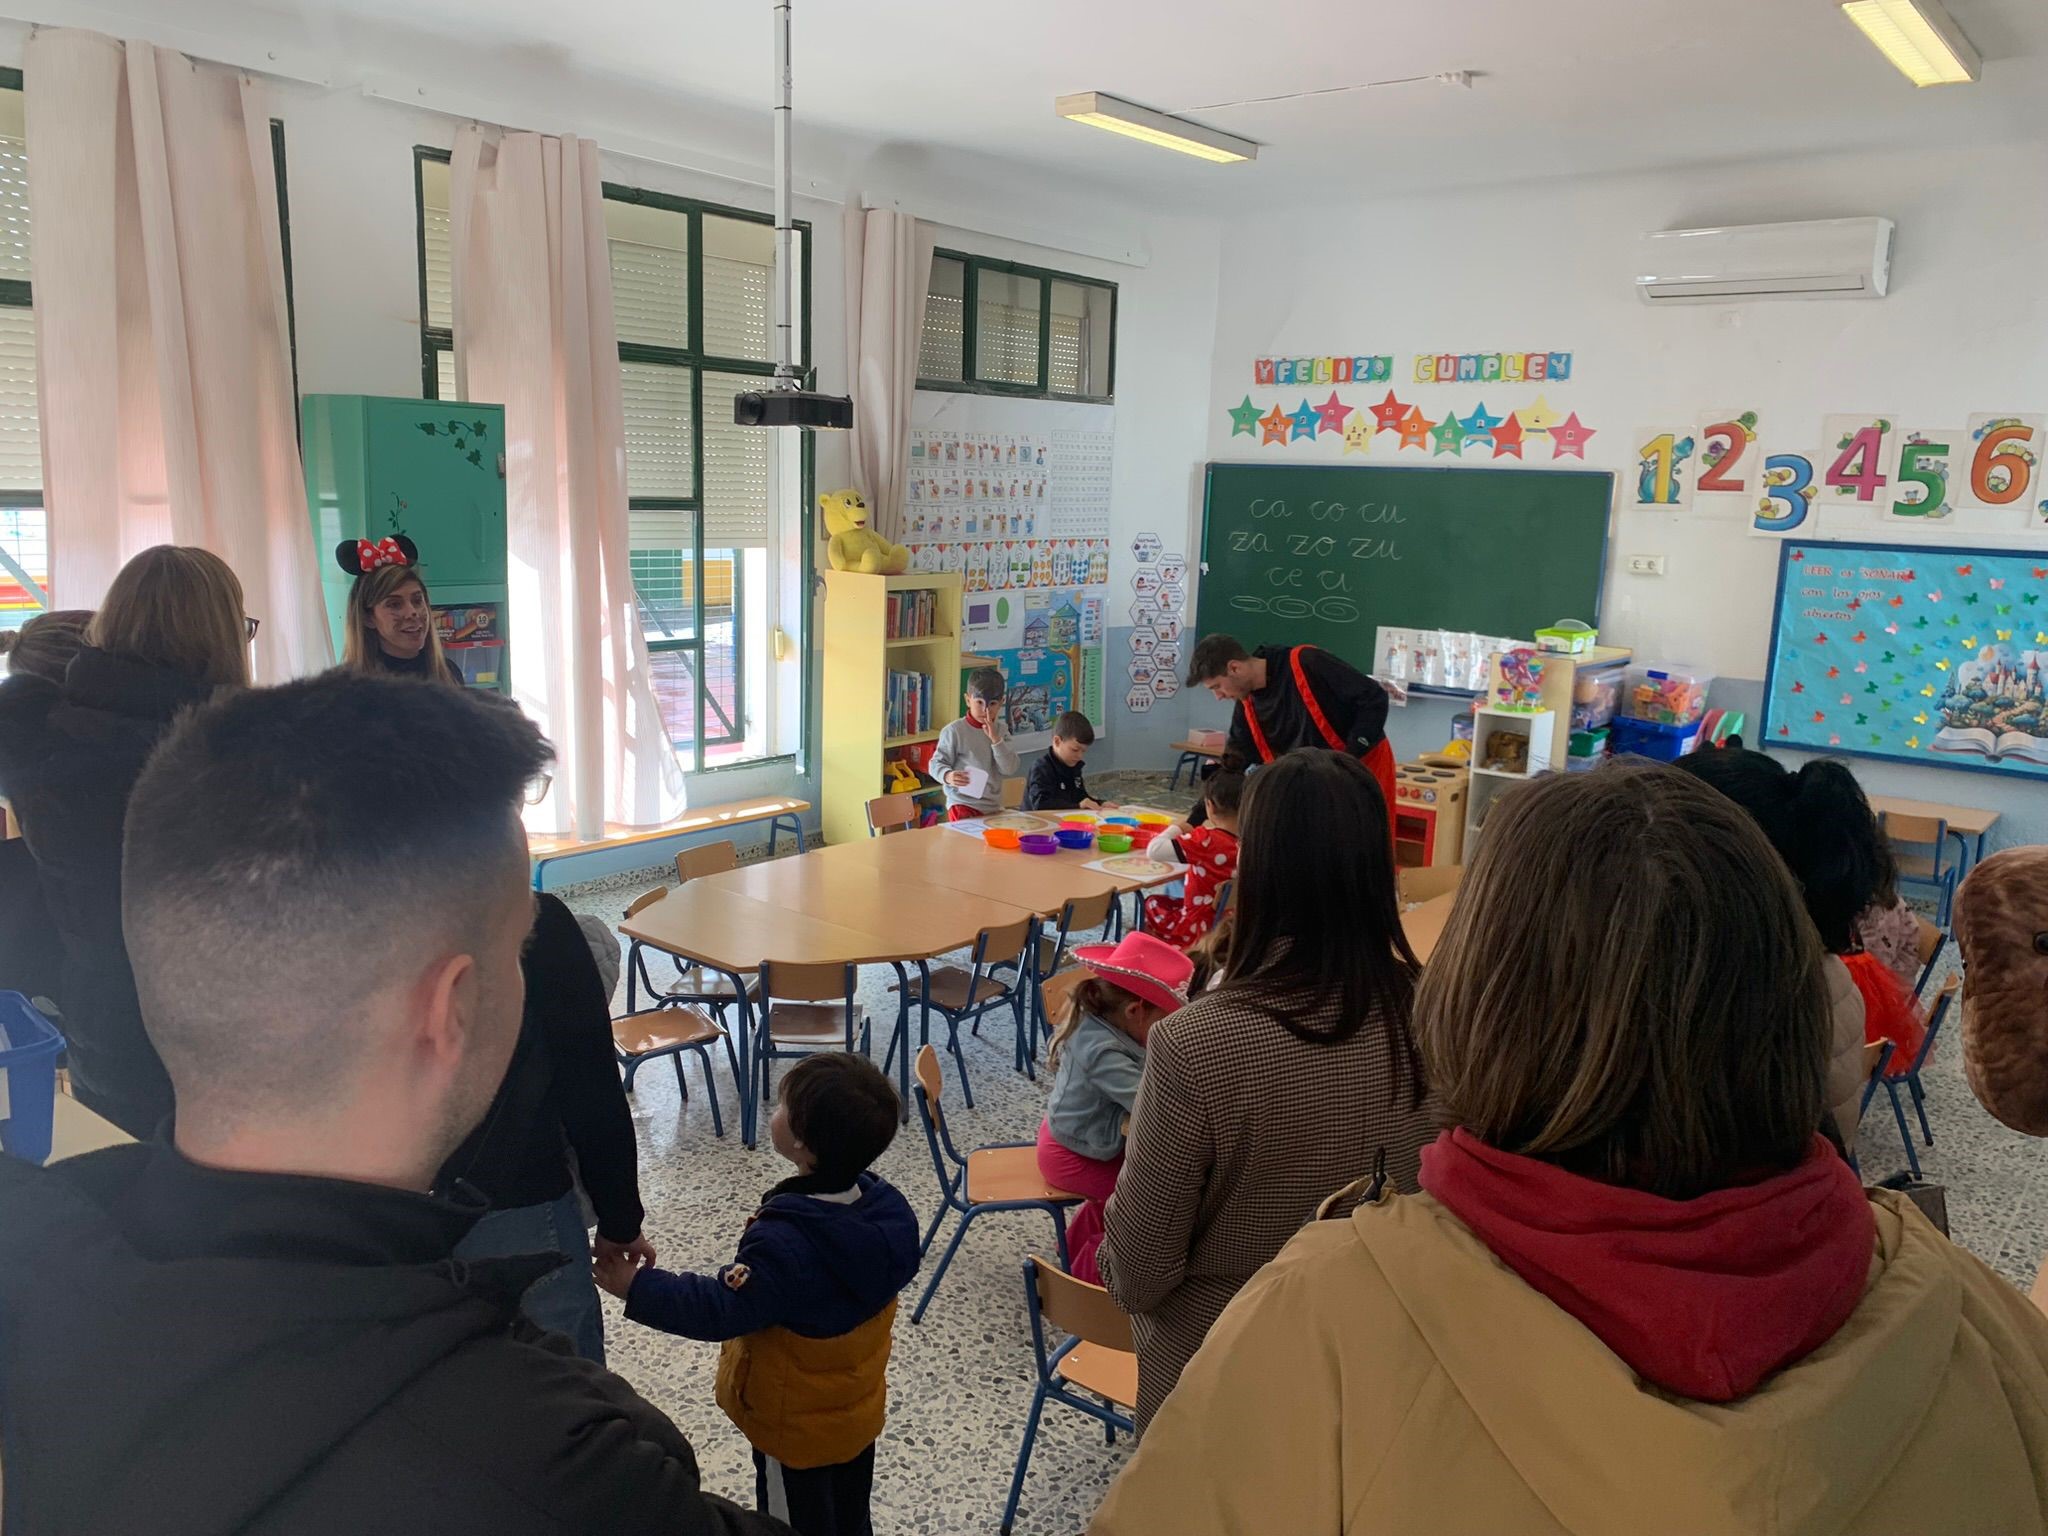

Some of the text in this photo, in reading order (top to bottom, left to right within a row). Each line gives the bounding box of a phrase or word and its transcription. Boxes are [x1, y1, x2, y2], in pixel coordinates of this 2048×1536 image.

[1639, 433, 1676, 504] 1
[1697, 422, 1747, 493] 2
[1754, 453, 1814, 532] 3
[1825, 427, 1887, 501] 4
[1892, 443, 1950, 517] 5
[1970, 425, 2035, 505] 6
[1228, 531, 1402, 560] za zo zu
[1250, 499, 1406, 523] ca co cu
[1266, 567, 1303, 587] ce
